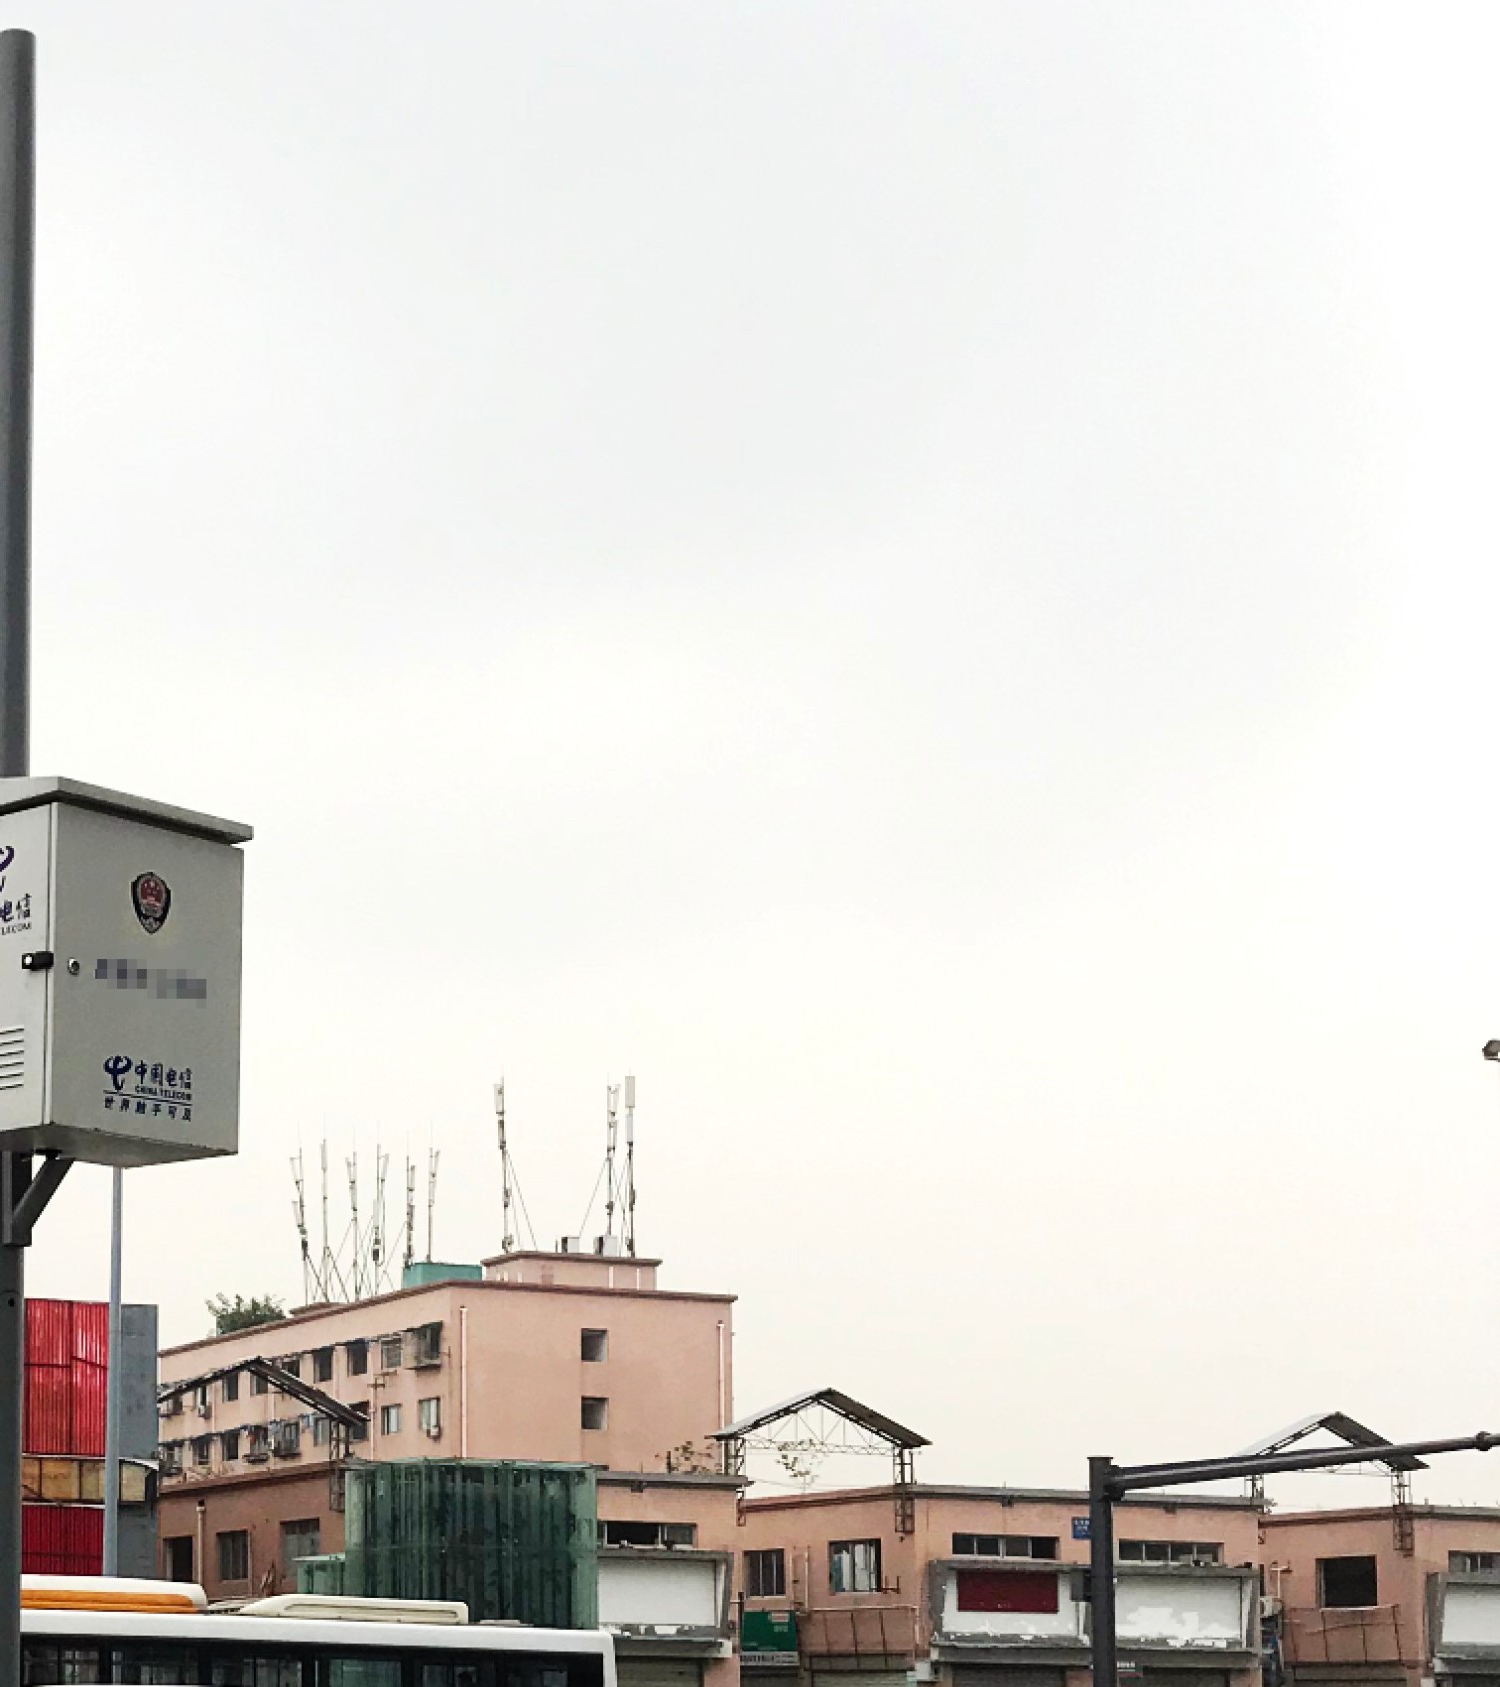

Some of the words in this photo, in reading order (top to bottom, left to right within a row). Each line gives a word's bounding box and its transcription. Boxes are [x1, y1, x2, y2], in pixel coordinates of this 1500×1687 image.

[135, 1060, 192, 1090] 中国电信
[135, 1085, 158, 1096] CHINA
[160, 1089, 192, 1101] TELECOM
